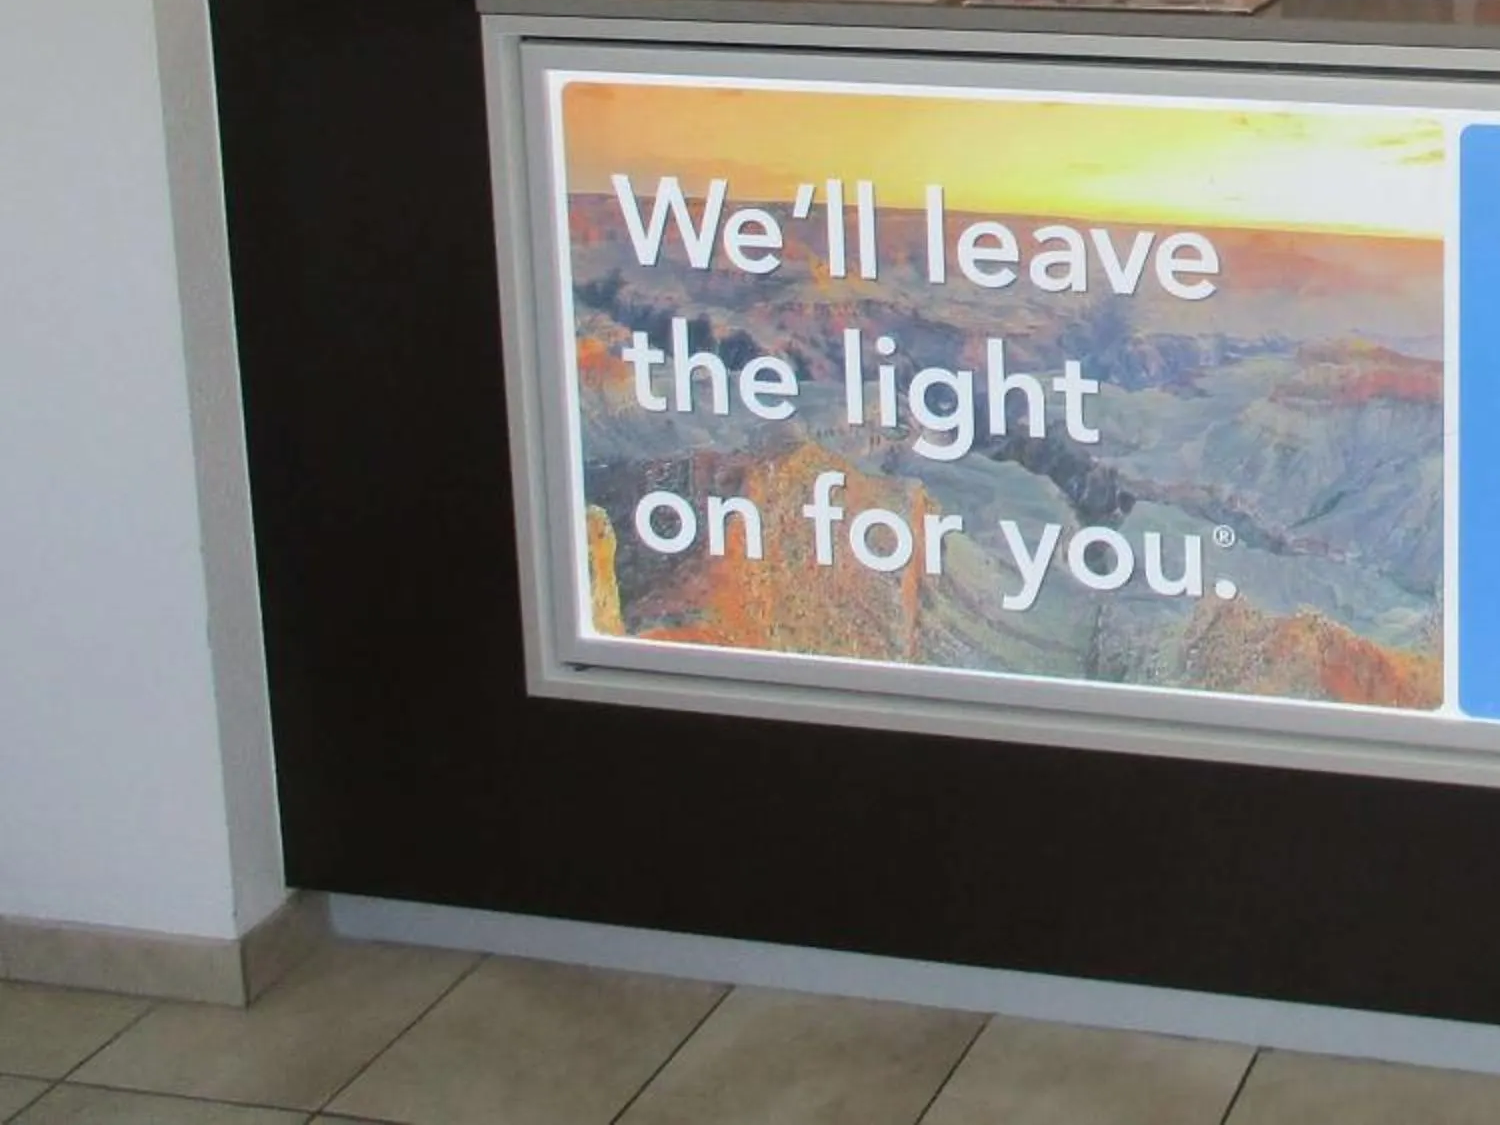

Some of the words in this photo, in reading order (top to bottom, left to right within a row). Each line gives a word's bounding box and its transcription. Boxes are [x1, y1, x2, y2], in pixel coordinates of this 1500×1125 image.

[612, 174, 876, 280] We'll
[926, 185, 1219, 300] leave
[622, 318, 799, 420] the
[844, 328, 1100, 461] light
[634, 489, 763, 559] on
[803, 471, 963, 574] for
